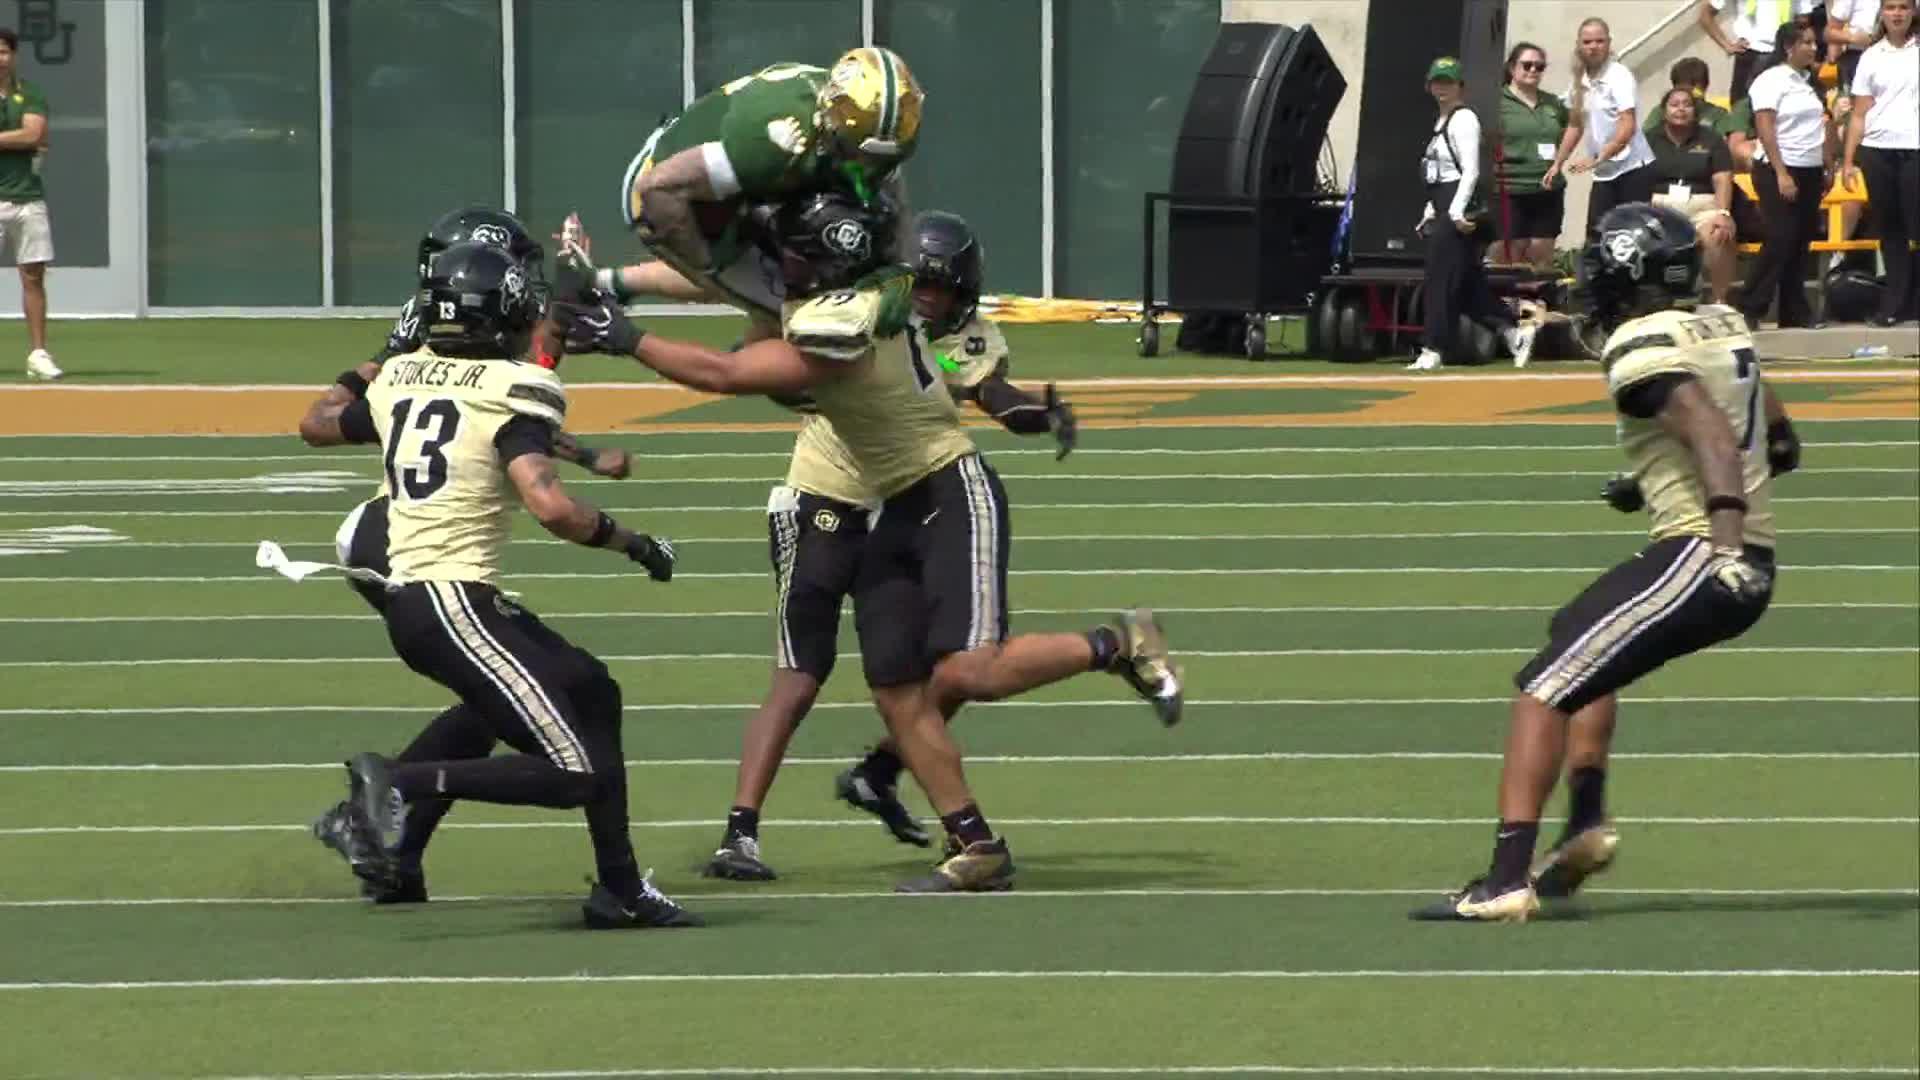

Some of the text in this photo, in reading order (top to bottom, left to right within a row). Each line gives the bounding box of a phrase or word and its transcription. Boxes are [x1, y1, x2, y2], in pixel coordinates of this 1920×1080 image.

[440, 301, 457, 320] 13
[388, 360, 488, 390] STOKES JR.
[385, 397, 461, 500] 13
